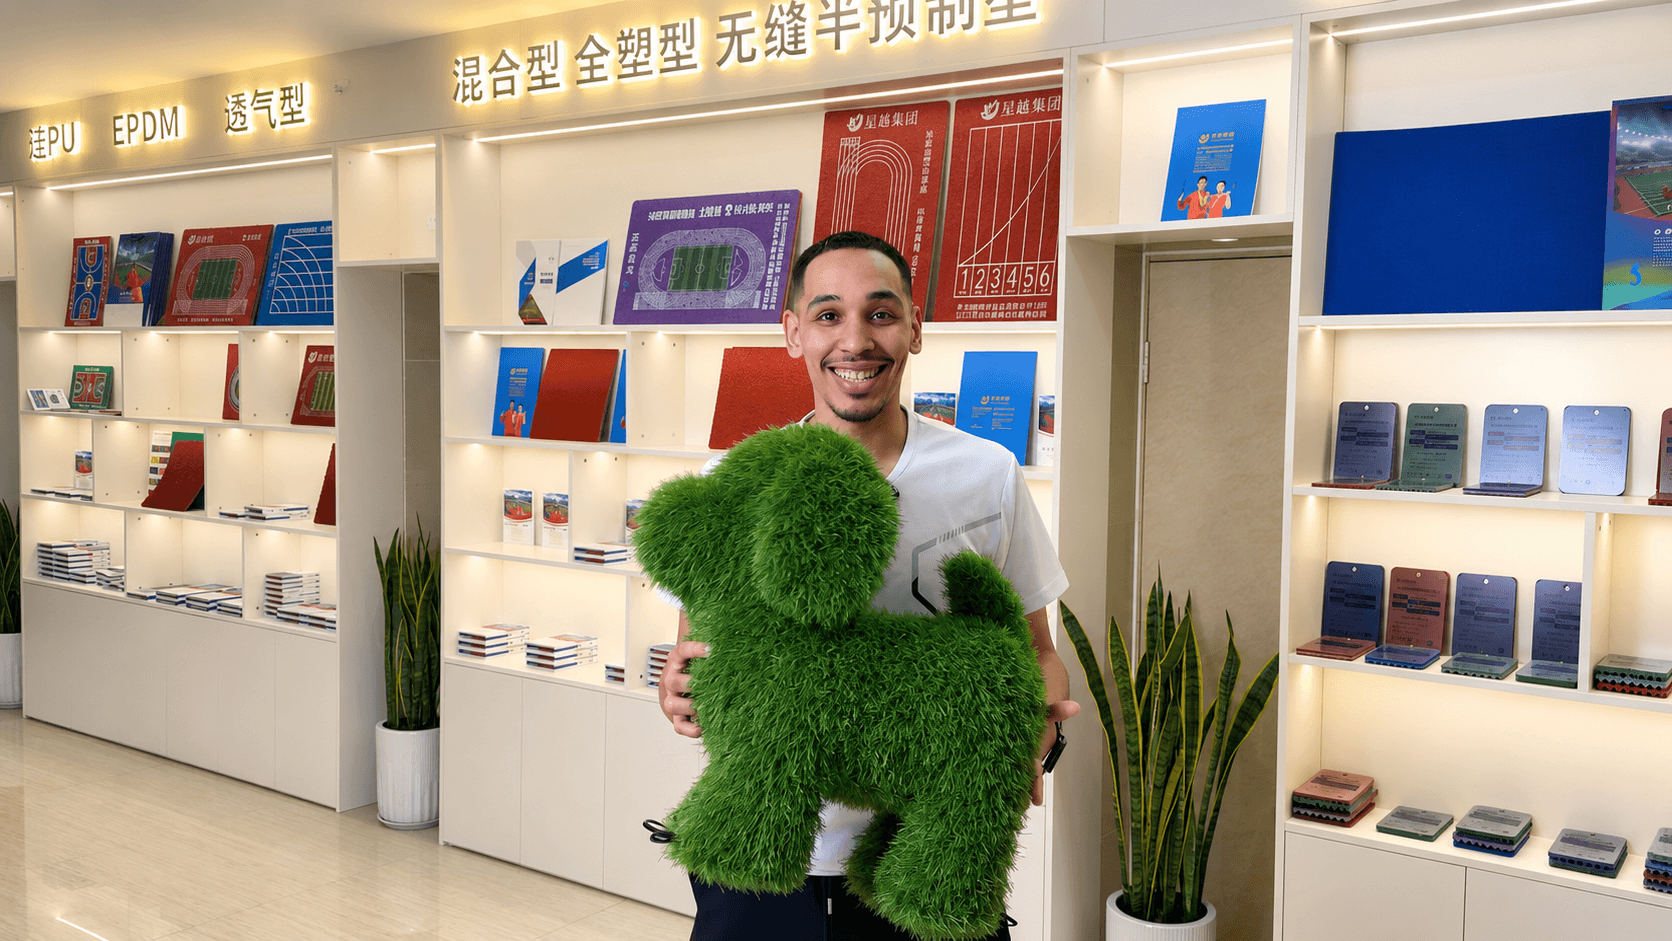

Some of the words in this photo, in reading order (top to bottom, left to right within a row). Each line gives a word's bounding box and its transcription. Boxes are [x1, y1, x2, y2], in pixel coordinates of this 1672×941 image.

[452, 40, 561, 104] 混合型
[574, 17, 698, 86] 全塑型
[112, 105, 179, 146] EPDM
[224, 82, 305, 134] 透气型
[1000, 95, 1061, 117] 星越集团
[961, 268, 969, 290] 1
[974, 268, 985, 290] 2
[990, 267, 1001, 289] 3
[1006, 266, 1018, 289] 4
[1023, 266, 1034, 288] 5
[1039, 264, 1050, 287] 6
